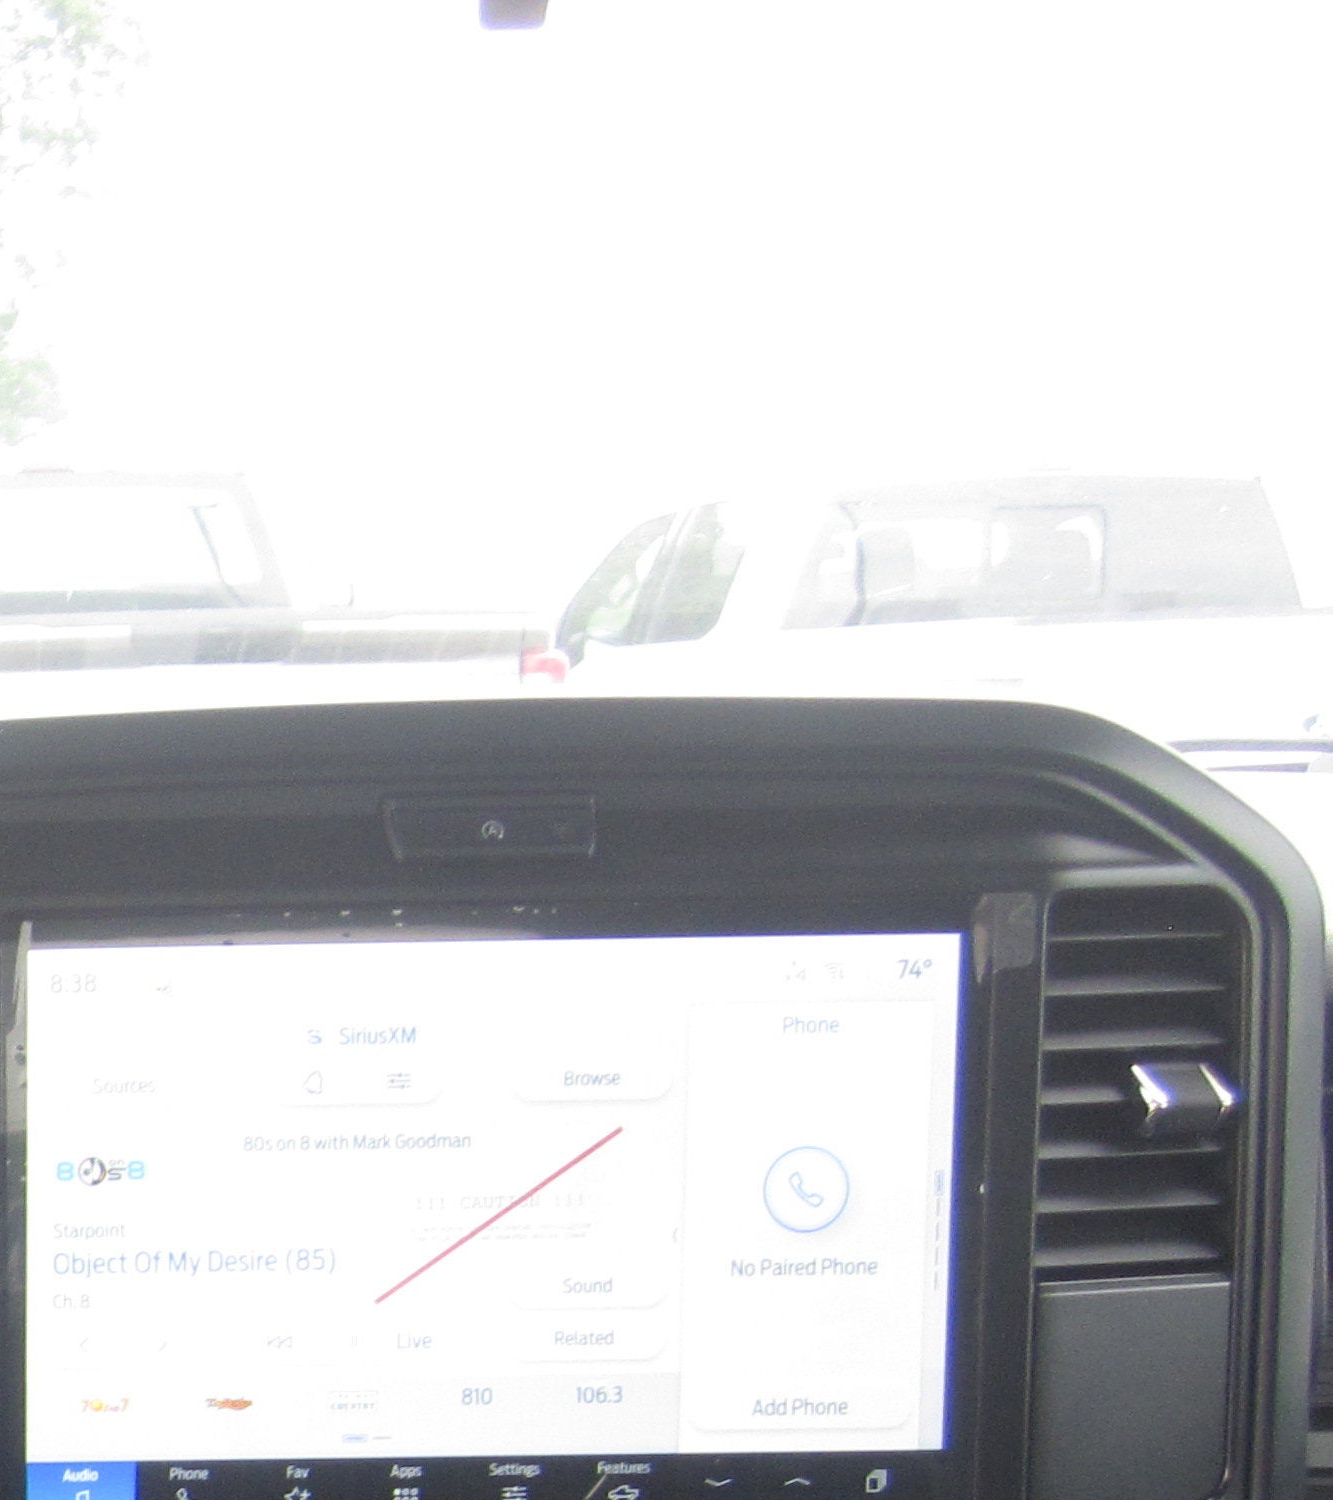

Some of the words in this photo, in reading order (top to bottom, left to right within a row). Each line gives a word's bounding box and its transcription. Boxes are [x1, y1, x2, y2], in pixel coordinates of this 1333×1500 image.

[897, 958, 933, 980] 74°
[50, 973, 97, 994] 8:38
[783, 1016, 840, 1034] Phone
[338, 1026, 417, 1046] SiriusXM
[92, 1077, 157, 1095] Sources
[563, 1070, 621, 1087] Browse
[243, 1135, 273, 1152] 80s
[276, 1138, 297, 1151] on
[300, 1134, 311, 1150] 8
[313, 1133, 349, 1150] with
[352, 1133, 391, 1150] Mark
[395, 1132, 472, 1150] Goodman
[53, 1222, 125, 1241] Starpoint
[53, 1250, 128, 1277] Object
[134, 1250, 163, 1273] Of
[168, 1250, 200, 1277] My
[208, 1249, 278, 1273] Desire
[285, 1247, 337, 1274] (85)
[730, 1259, 755, 1277] No
[760, 1258, 817, 1276] Paired
[821, 1258, 879, 1275] Phone
[563, 1277, 613, 1294] Sound
[80, 1294, 90, 1310] 8
[397, 1332, 432, 1350] Live
[554, 1329, 614, 1347] Related
[460, 1387, 493, 1406] 810
[575, 1385, 623, 1404] 106.3
[752, 1398, 788, 1416] Add
[791, 1397, 849, 1416] Phone
[62, 1468, 99, 1482] Audio
[169, 1467, 208, 1481] Phone
[286, 1465, 310, 1479] Fav
[390, 1464, 422, 1478] Apps
[489, 1462, 541, 1478] Settings
[597, 1460, 650, 1475] Features
